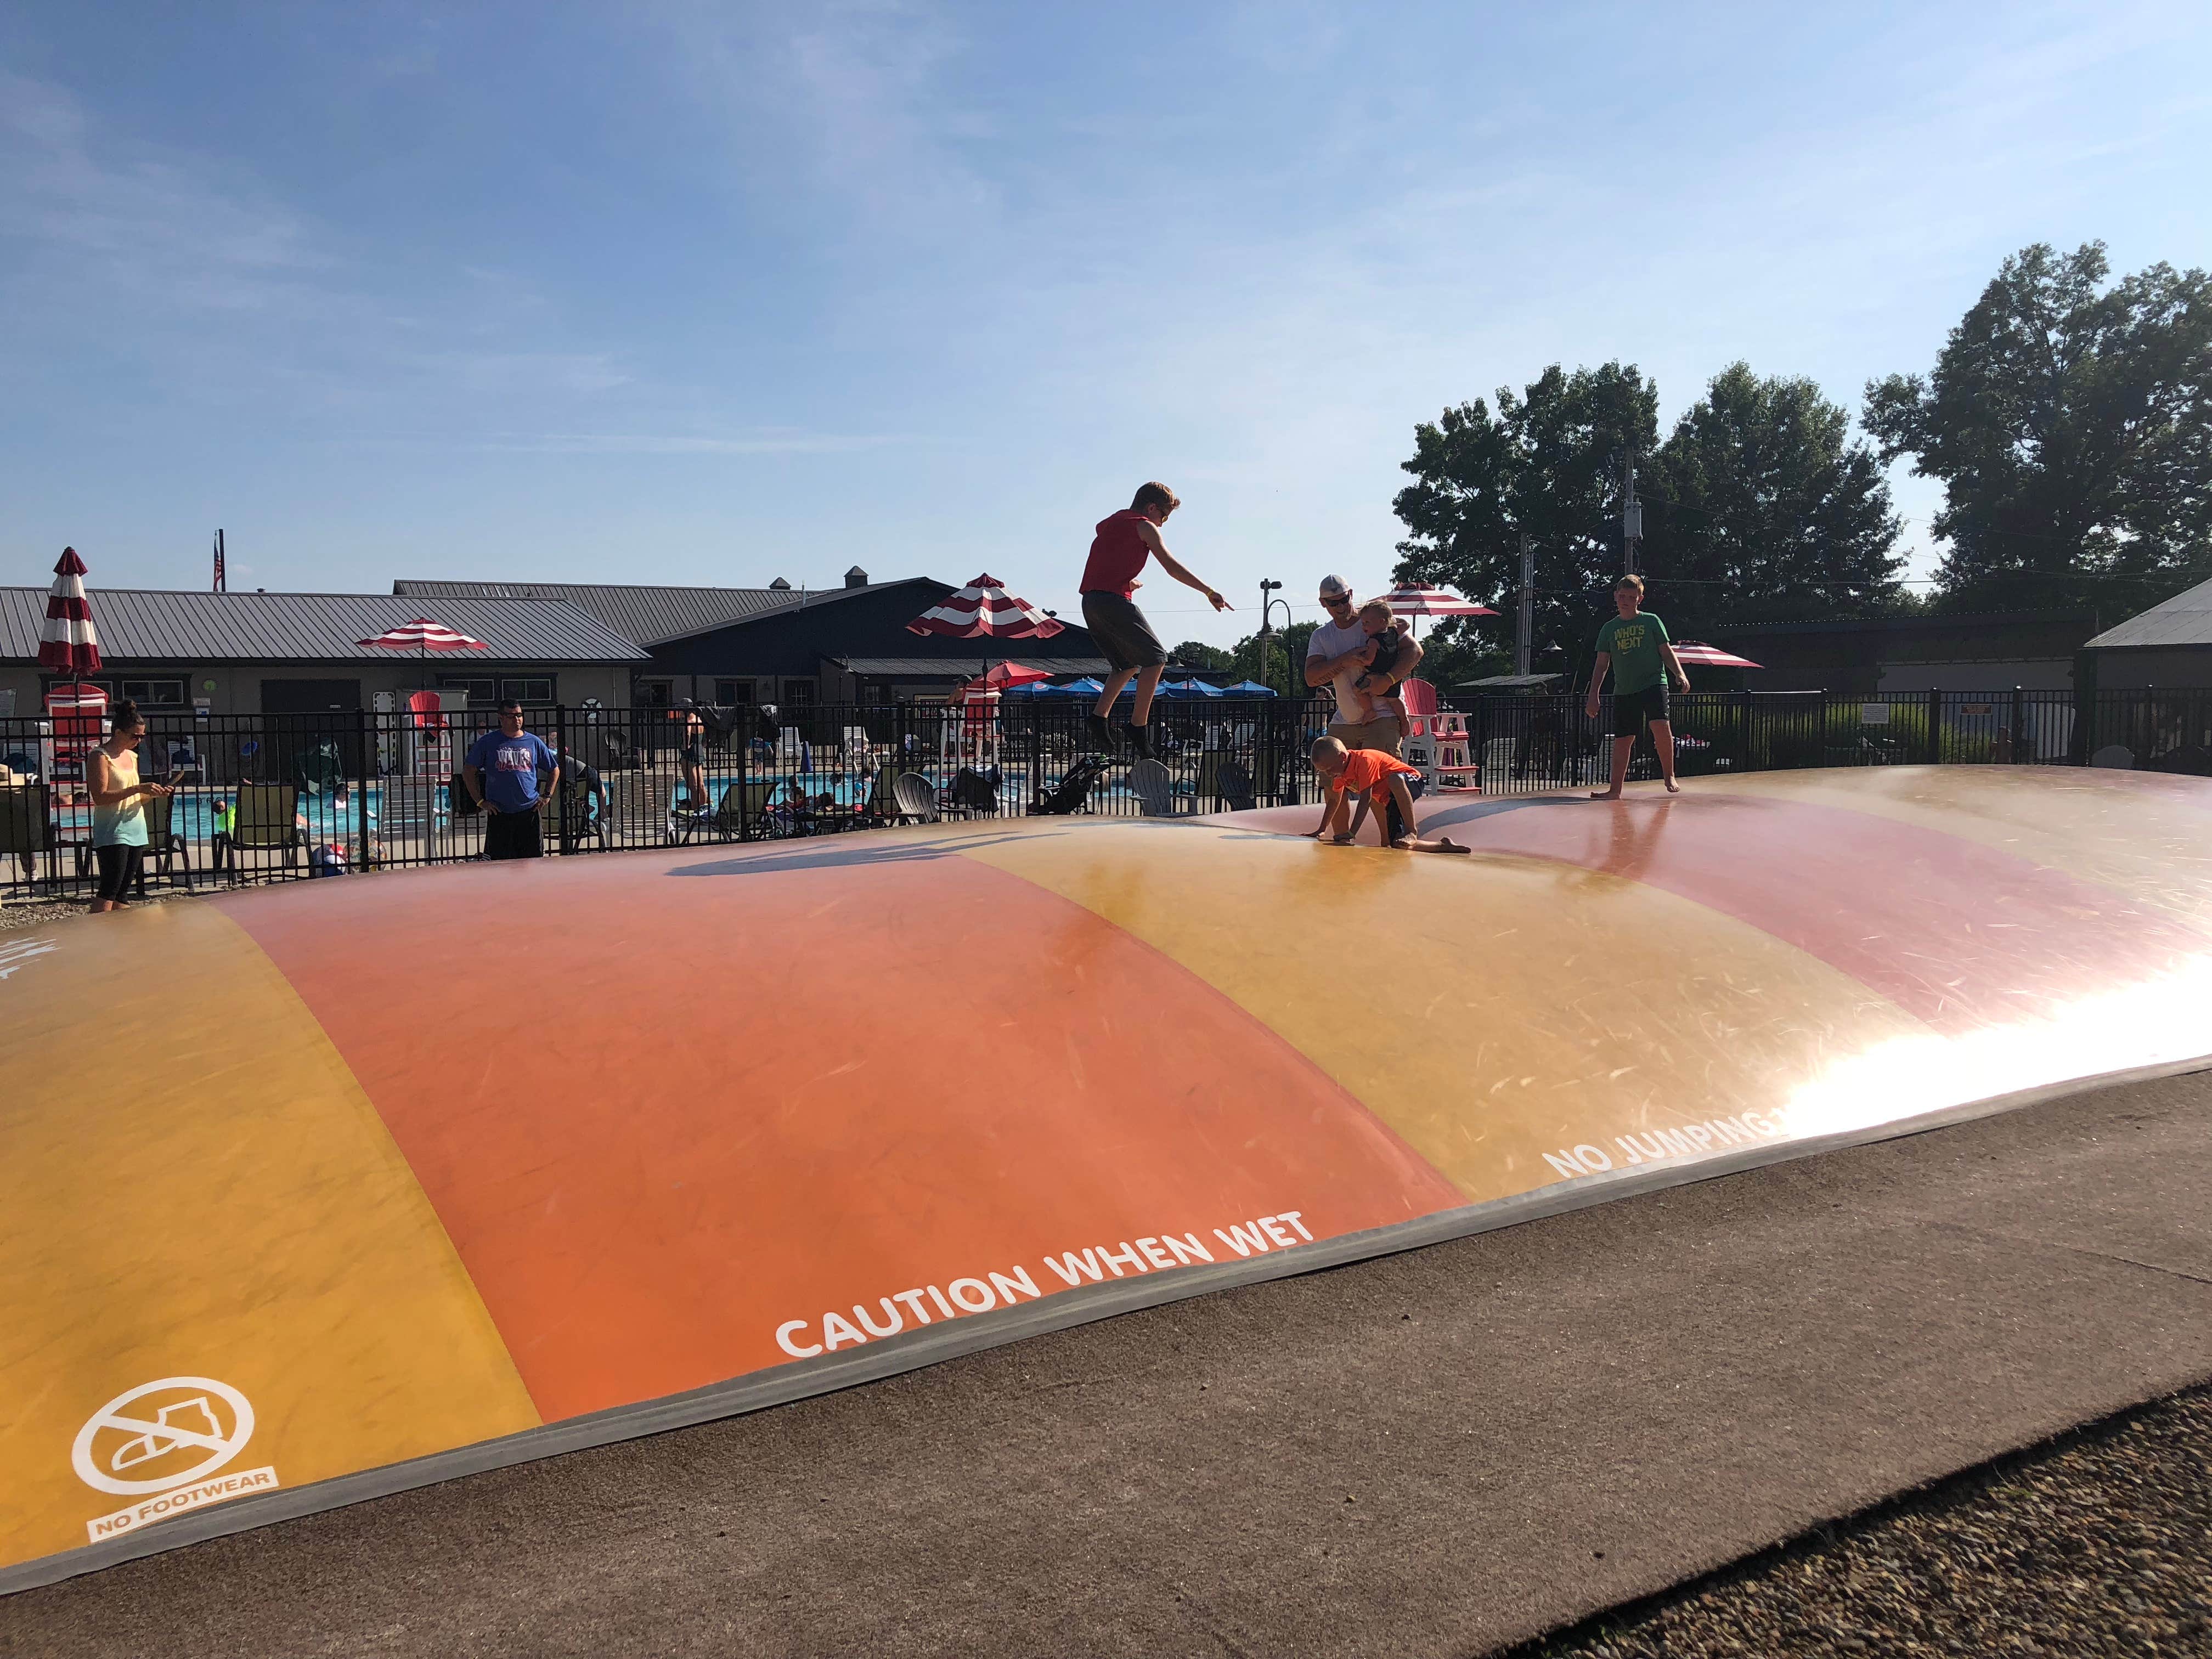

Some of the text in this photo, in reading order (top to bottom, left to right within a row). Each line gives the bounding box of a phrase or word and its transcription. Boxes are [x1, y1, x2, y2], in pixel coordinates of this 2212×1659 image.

[1615, 625, 1645, 640] WHO'S
[1617, 636, 1643, 650] NEXT
[1542, 1144, 1612, 1178] NO
[1615, 1112, 1775, 1164] JUMPING
[776, 1211, 1313, 1358] CAUTION WHEN WET
[95, 1472, 270, 1535] NO FOOTWEAR
